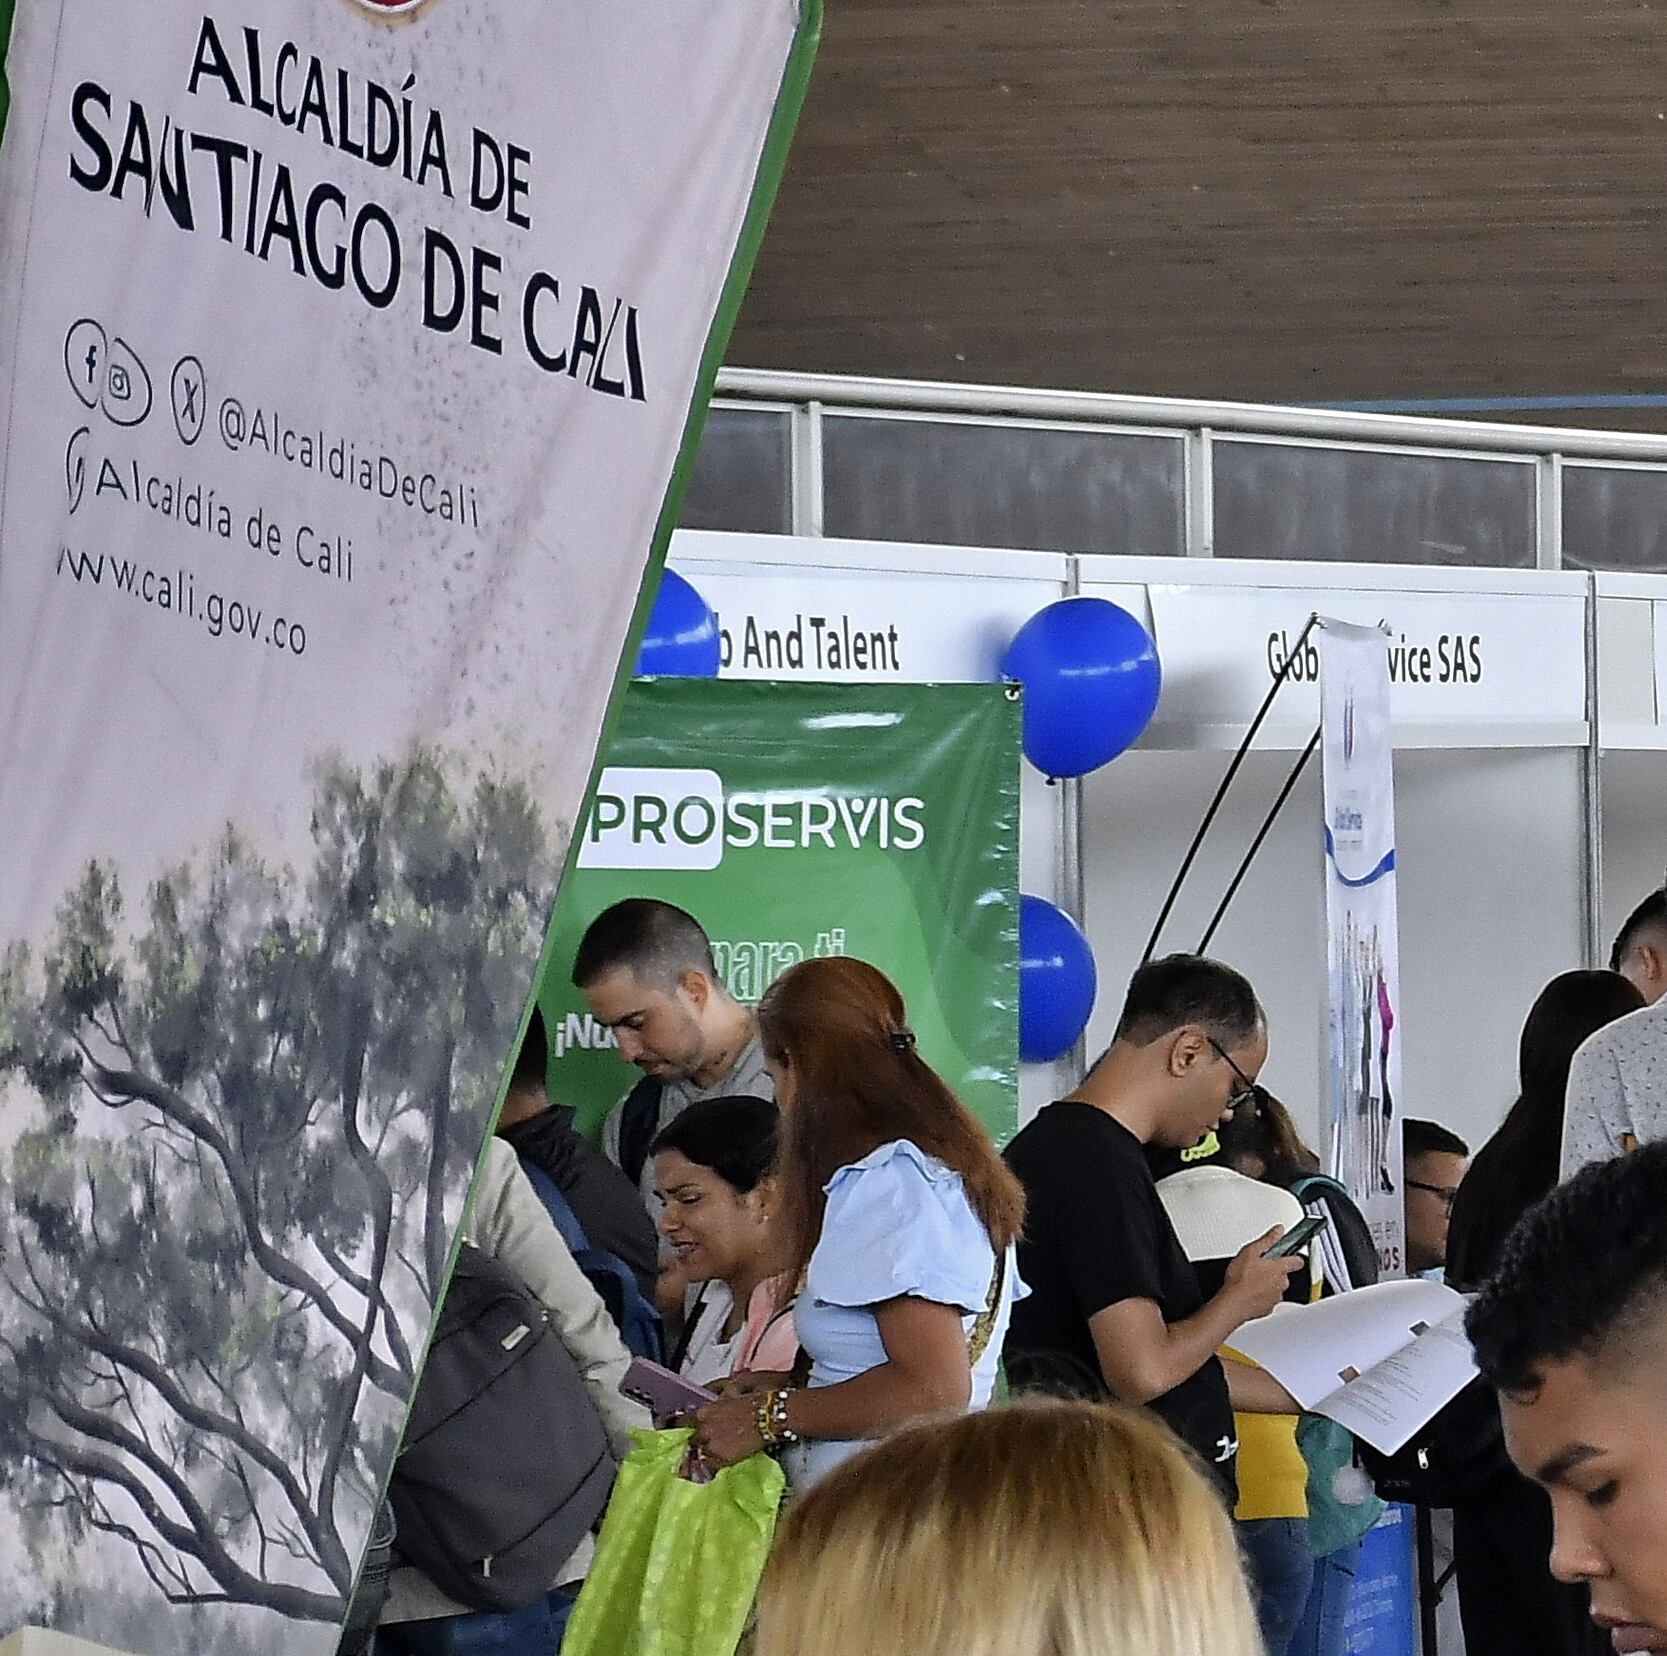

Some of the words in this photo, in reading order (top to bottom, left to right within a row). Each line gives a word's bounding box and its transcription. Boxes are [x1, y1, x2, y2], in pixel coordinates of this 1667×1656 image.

[188, 16, 455, 199] ALCALDÍA
[470, 128, 532, 229] DE
[69, 82, 401, 309] SANTIAGO
[423, 228, 503, 354] DE
[523, 272, 647, 402] CALI
[96, 459, 231, 538] Alcaldía
[247, 508, 281, 557] de
[297, 527, 353, 581] Cali
[219, 398, 478, 528] @AlcaldiaDeCali
[57, 547, 306, 655] ww.cali.gov.co
[744, 614, 803, 669] And
[809, 614, 899, 671] Talent
[1268, 630, 1319, 682] Glob
[1387, 633, 1432, 683] vice
[1438, 635, 1481, 683] SAS
